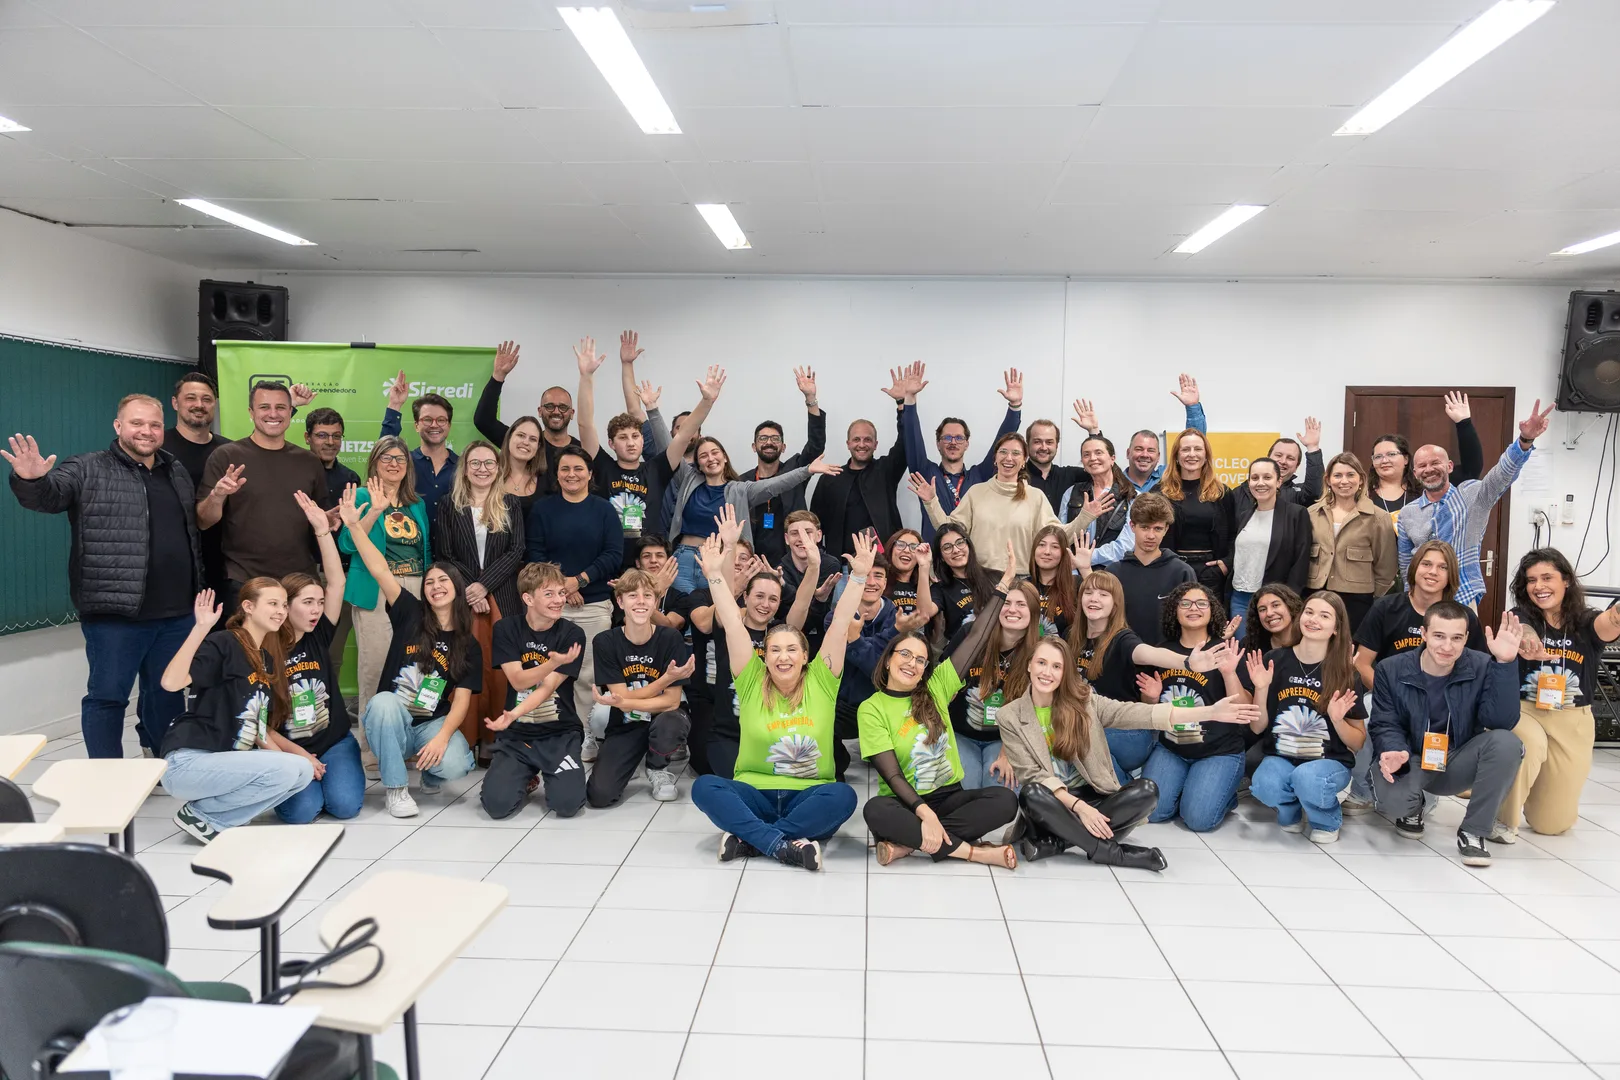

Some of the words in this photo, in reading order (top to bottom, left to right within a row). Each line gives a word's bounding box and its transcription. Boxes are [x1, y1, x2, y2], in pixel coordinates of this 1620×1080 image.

[408, 381, 473, 399] Sicredi
[1212, 457, 1250, 469] CLEO
[1288, 675, 1321, 688] GERAÇÃO
